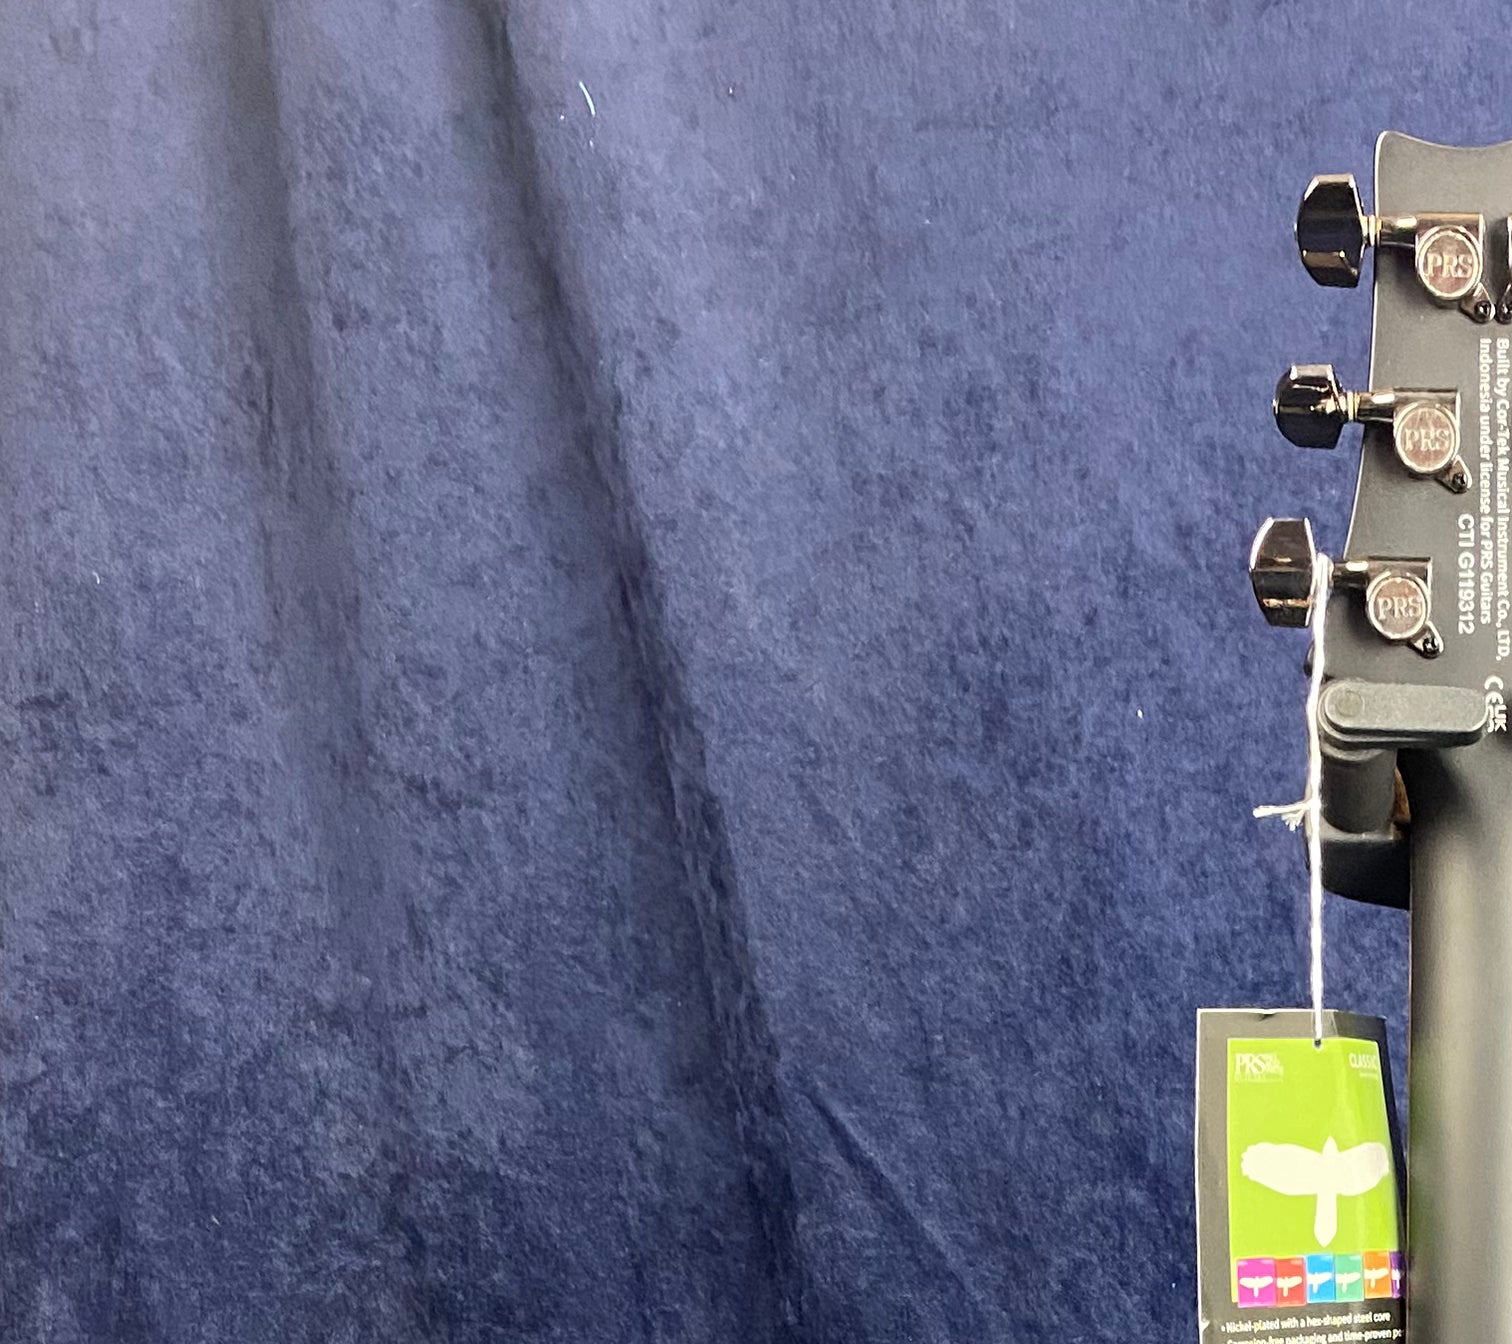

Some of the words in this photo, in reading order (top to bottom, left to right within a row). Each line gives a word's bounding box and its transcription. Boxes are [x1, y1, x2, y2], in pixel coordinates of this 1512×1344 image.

[1425, 252, 1473, 278] PRS
[1496, 338, 1510, 375] Built
[1479, 338, 1493, 413] Indonesia
[1493, 377, 1510, 397] by
[1403, 428, 1450, 452] PRS
[1479, 415, 1493, 460] under
[1496, 399, 1510, 456] Cor-Tek
[1480, 462, 1493, 514] license
[1496, 458, 1510, 513] Musical
[1458, 513, 1475, 547] CTI
[1480, 516, 1494, 539] for
[1480, 540, 1493, 570] PRS
[1497, 516, 1510, 597] Instrument
[1377, 597, 1422, 621] PRS
[1458, 551, 1475, 635] G119312
[1480, 571, 1493, 624] Guitars
[1495, 629, 1510, 661] LTD.
[1235, 1053, 1265, 1074] PRS
[1226, 1318, 1280, 1334] Nickel-plated
[1280, 1316, 1299, 1329] with
[1300, 1318, 1306, 1328] a
[1353, 1311, 1373, 1324] steel
[1373, 1312, 1391, 1323] core
[1327, 1330, 1343, 1343] and
[1344, 1329, 1392, 1342] time-proven
